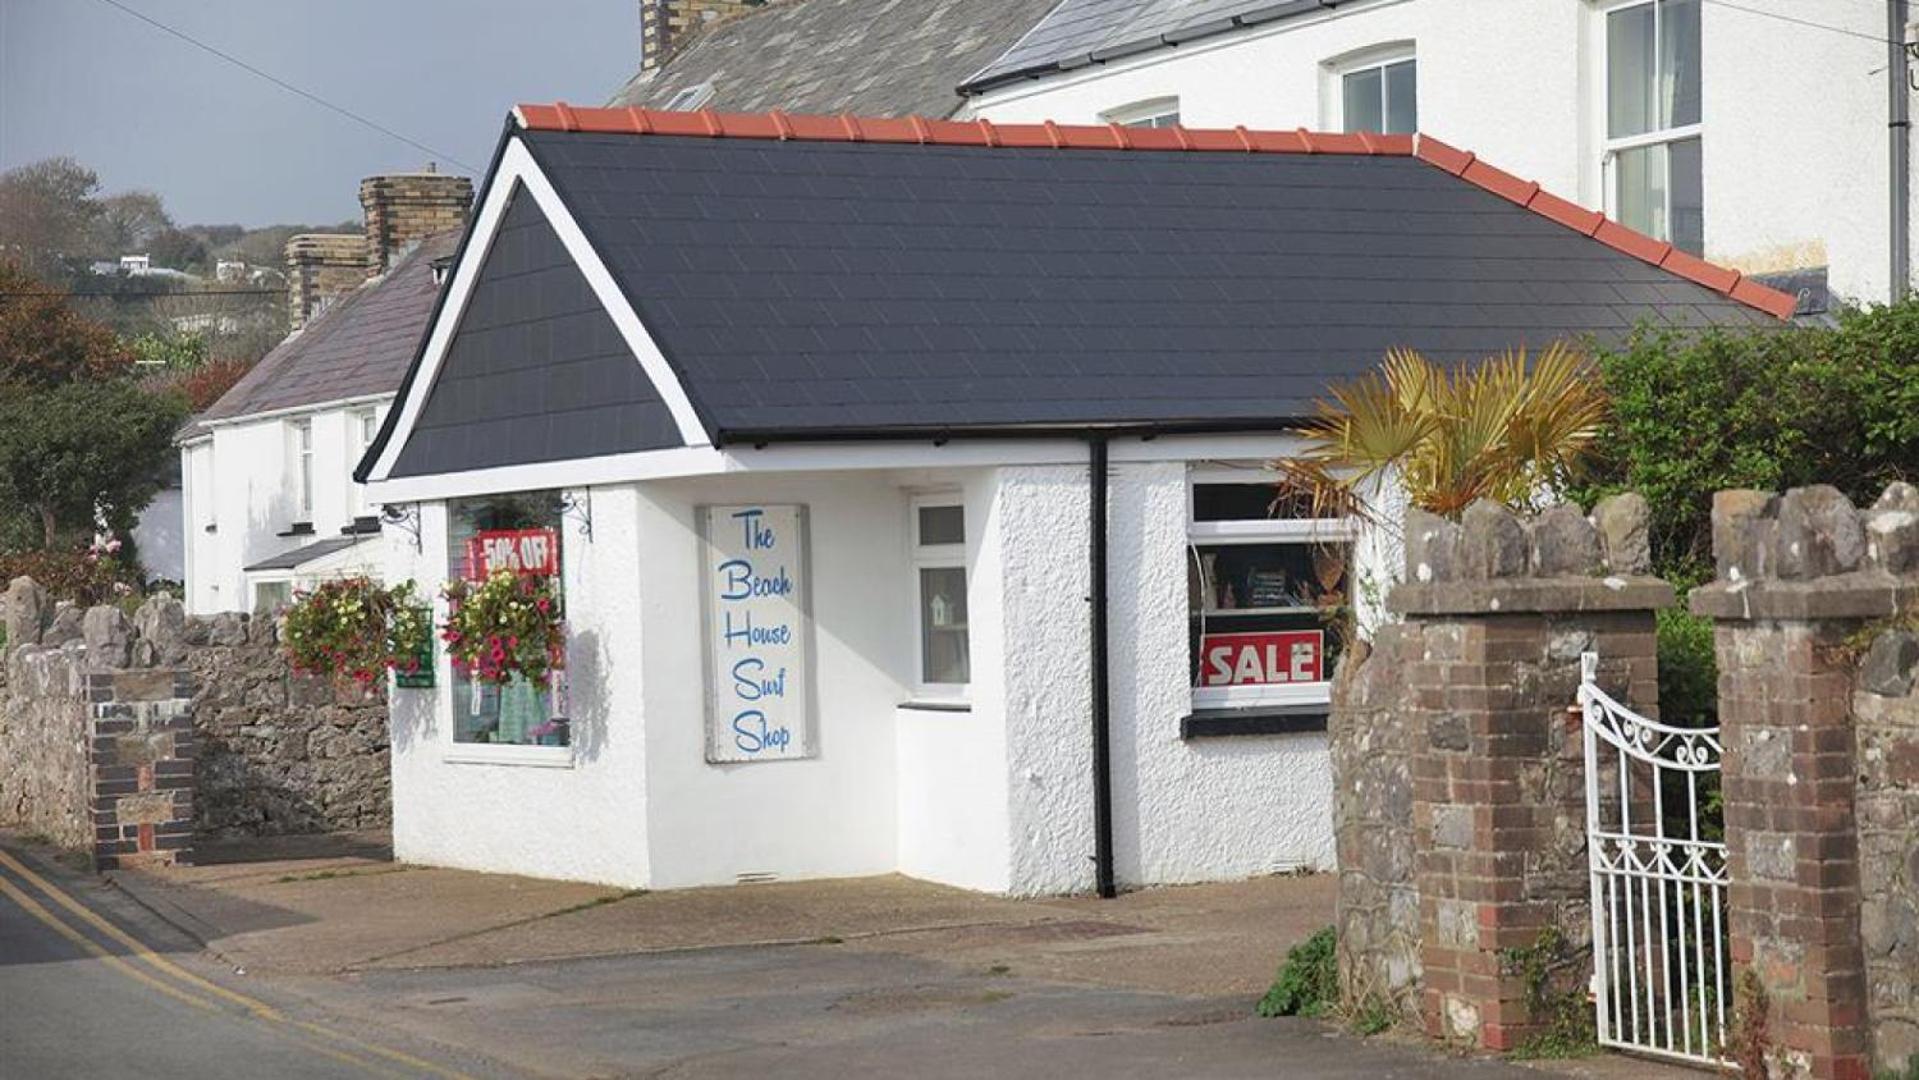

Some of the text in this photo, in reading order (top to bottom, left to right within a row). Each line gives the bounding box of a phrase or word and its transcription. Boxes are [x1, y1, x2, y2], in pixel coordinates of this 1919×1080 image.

[732, 509, 775, 549] The
[483, 535, 548, 571] 50% OFF
[718, 560, 793, 600] Beach
[724, 610, 792, 648] House
[732, 658, 786, 701] Surf
[1208, 643, 1314, 684] SALE
[733, 709, 790, 753] Shop
